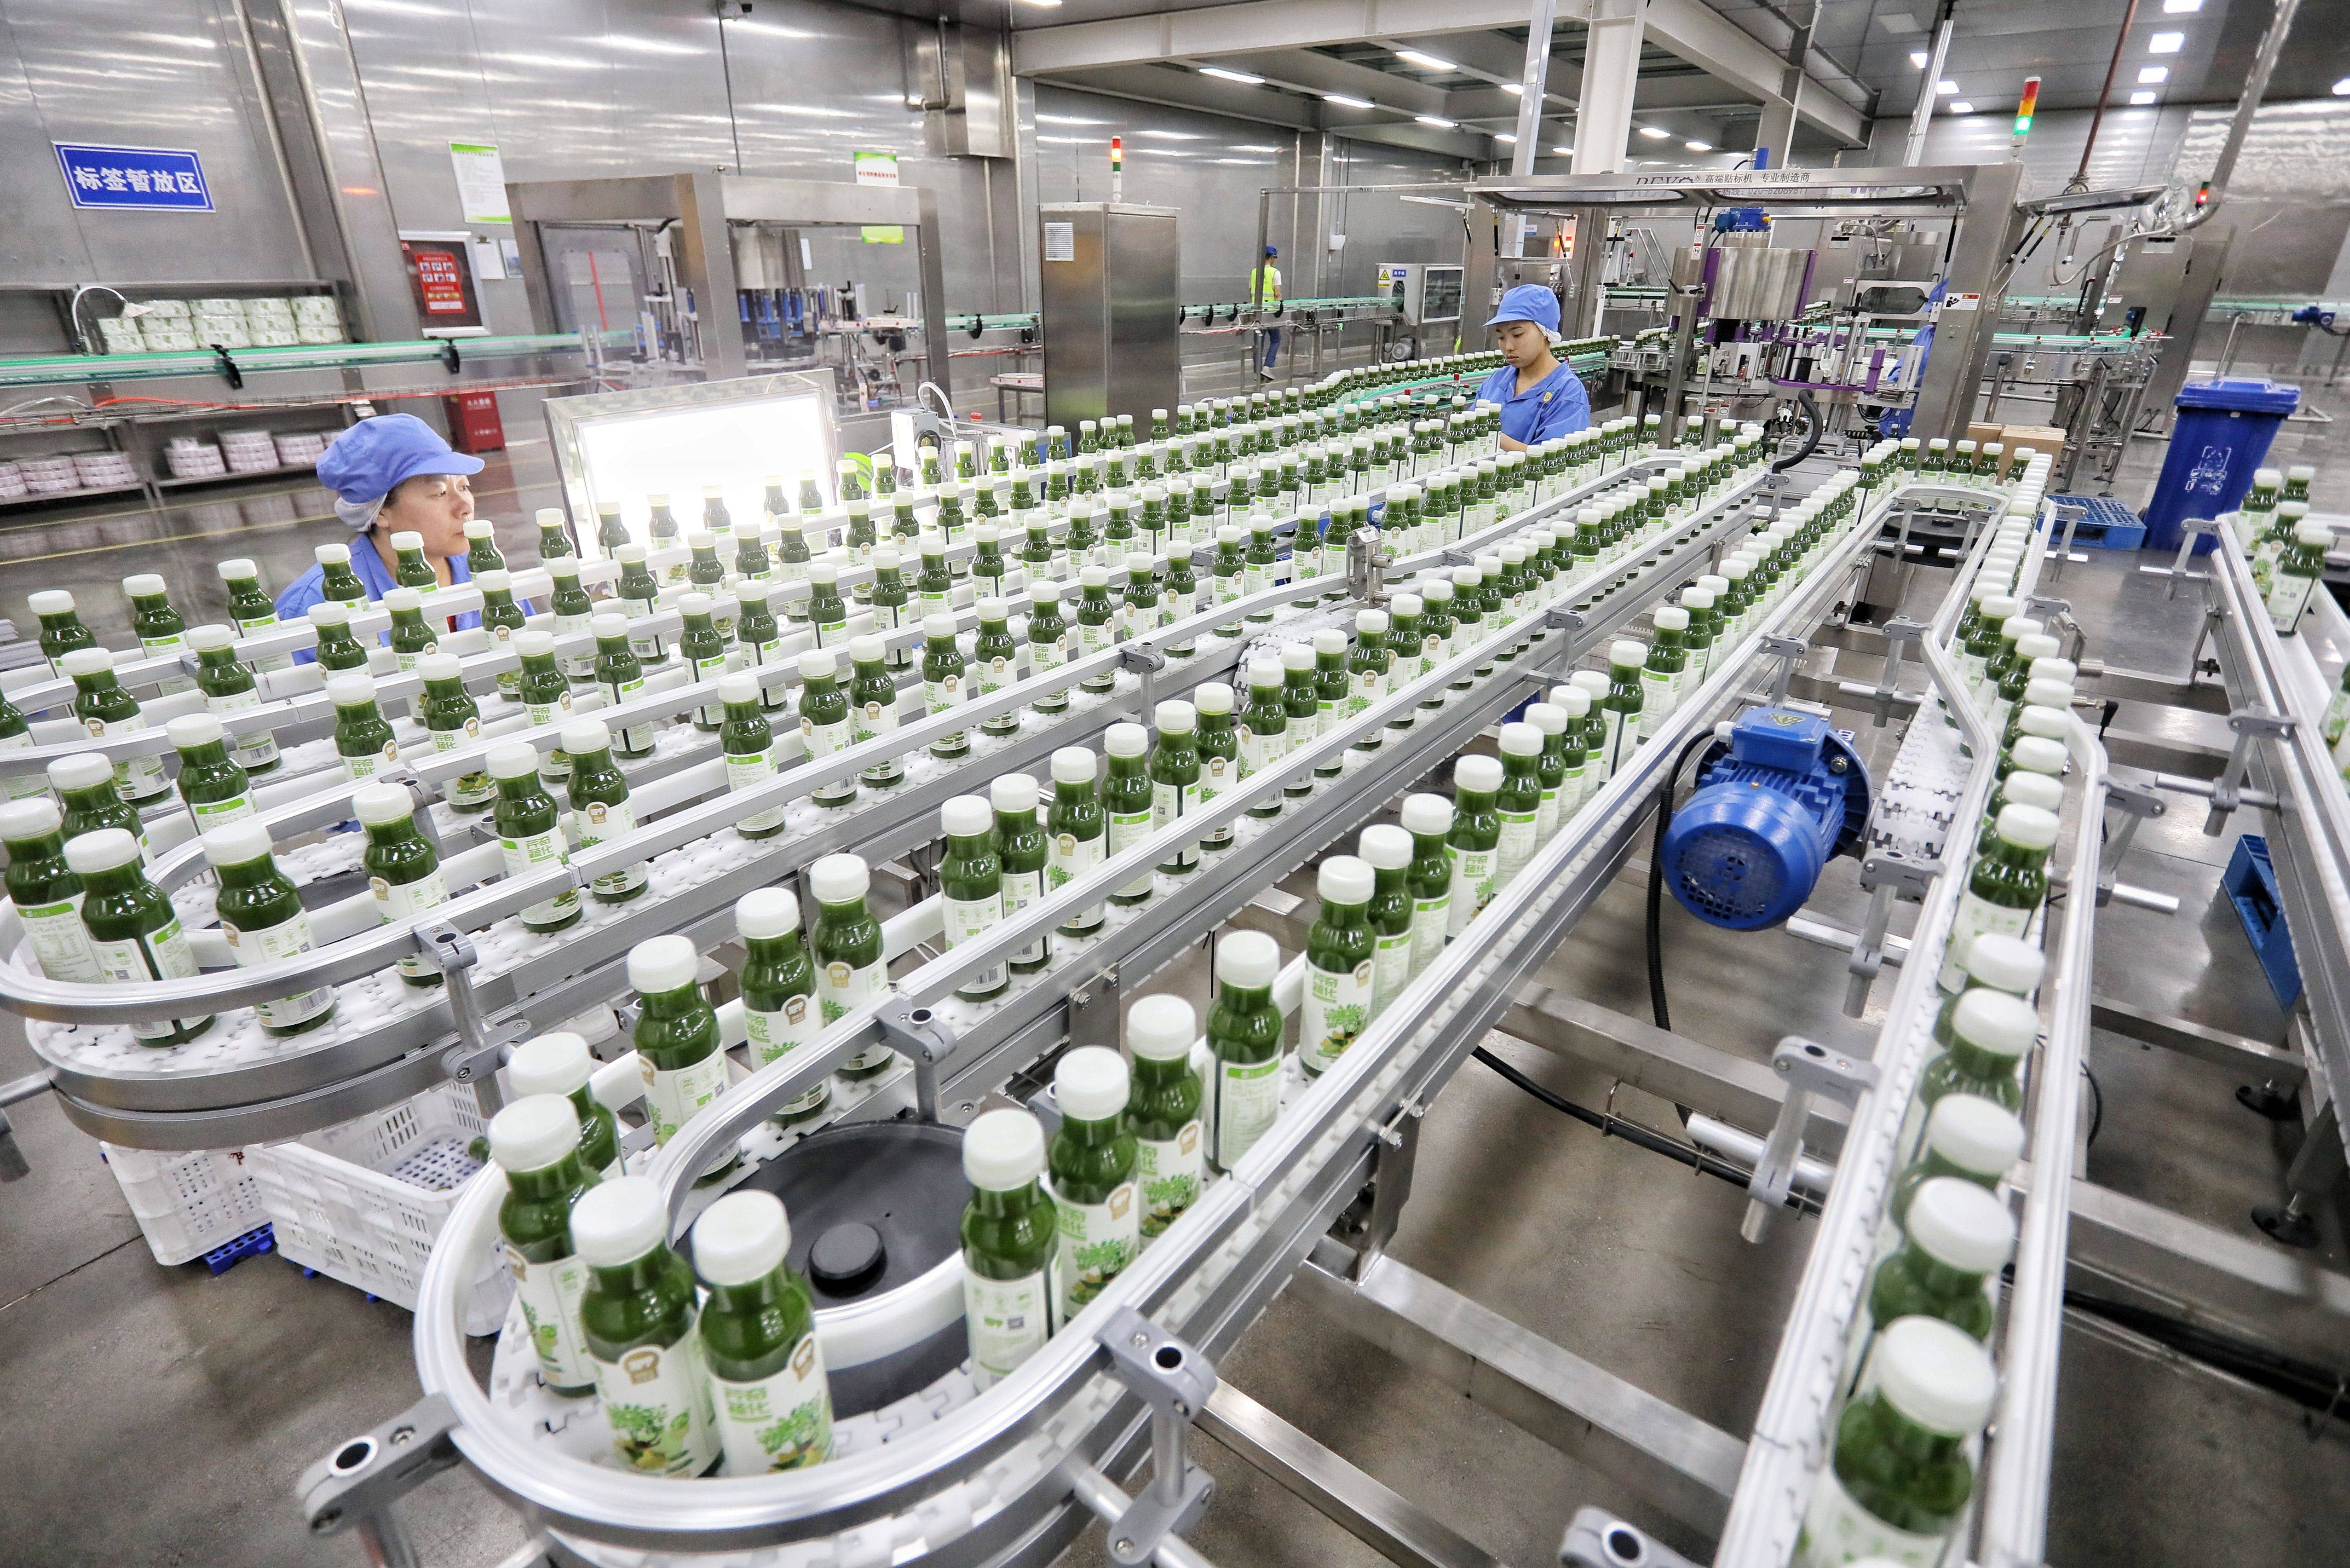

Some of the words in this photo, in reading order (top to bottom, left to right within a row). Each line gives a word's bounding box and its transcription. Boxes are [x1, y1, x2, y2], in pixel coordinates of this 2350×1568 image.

[73, 165, 201, 194] 标签暂放区
[1705, 174, 1752, 184] 高端贴标机
[1760, 172, 1811, 182] 专业制造商
